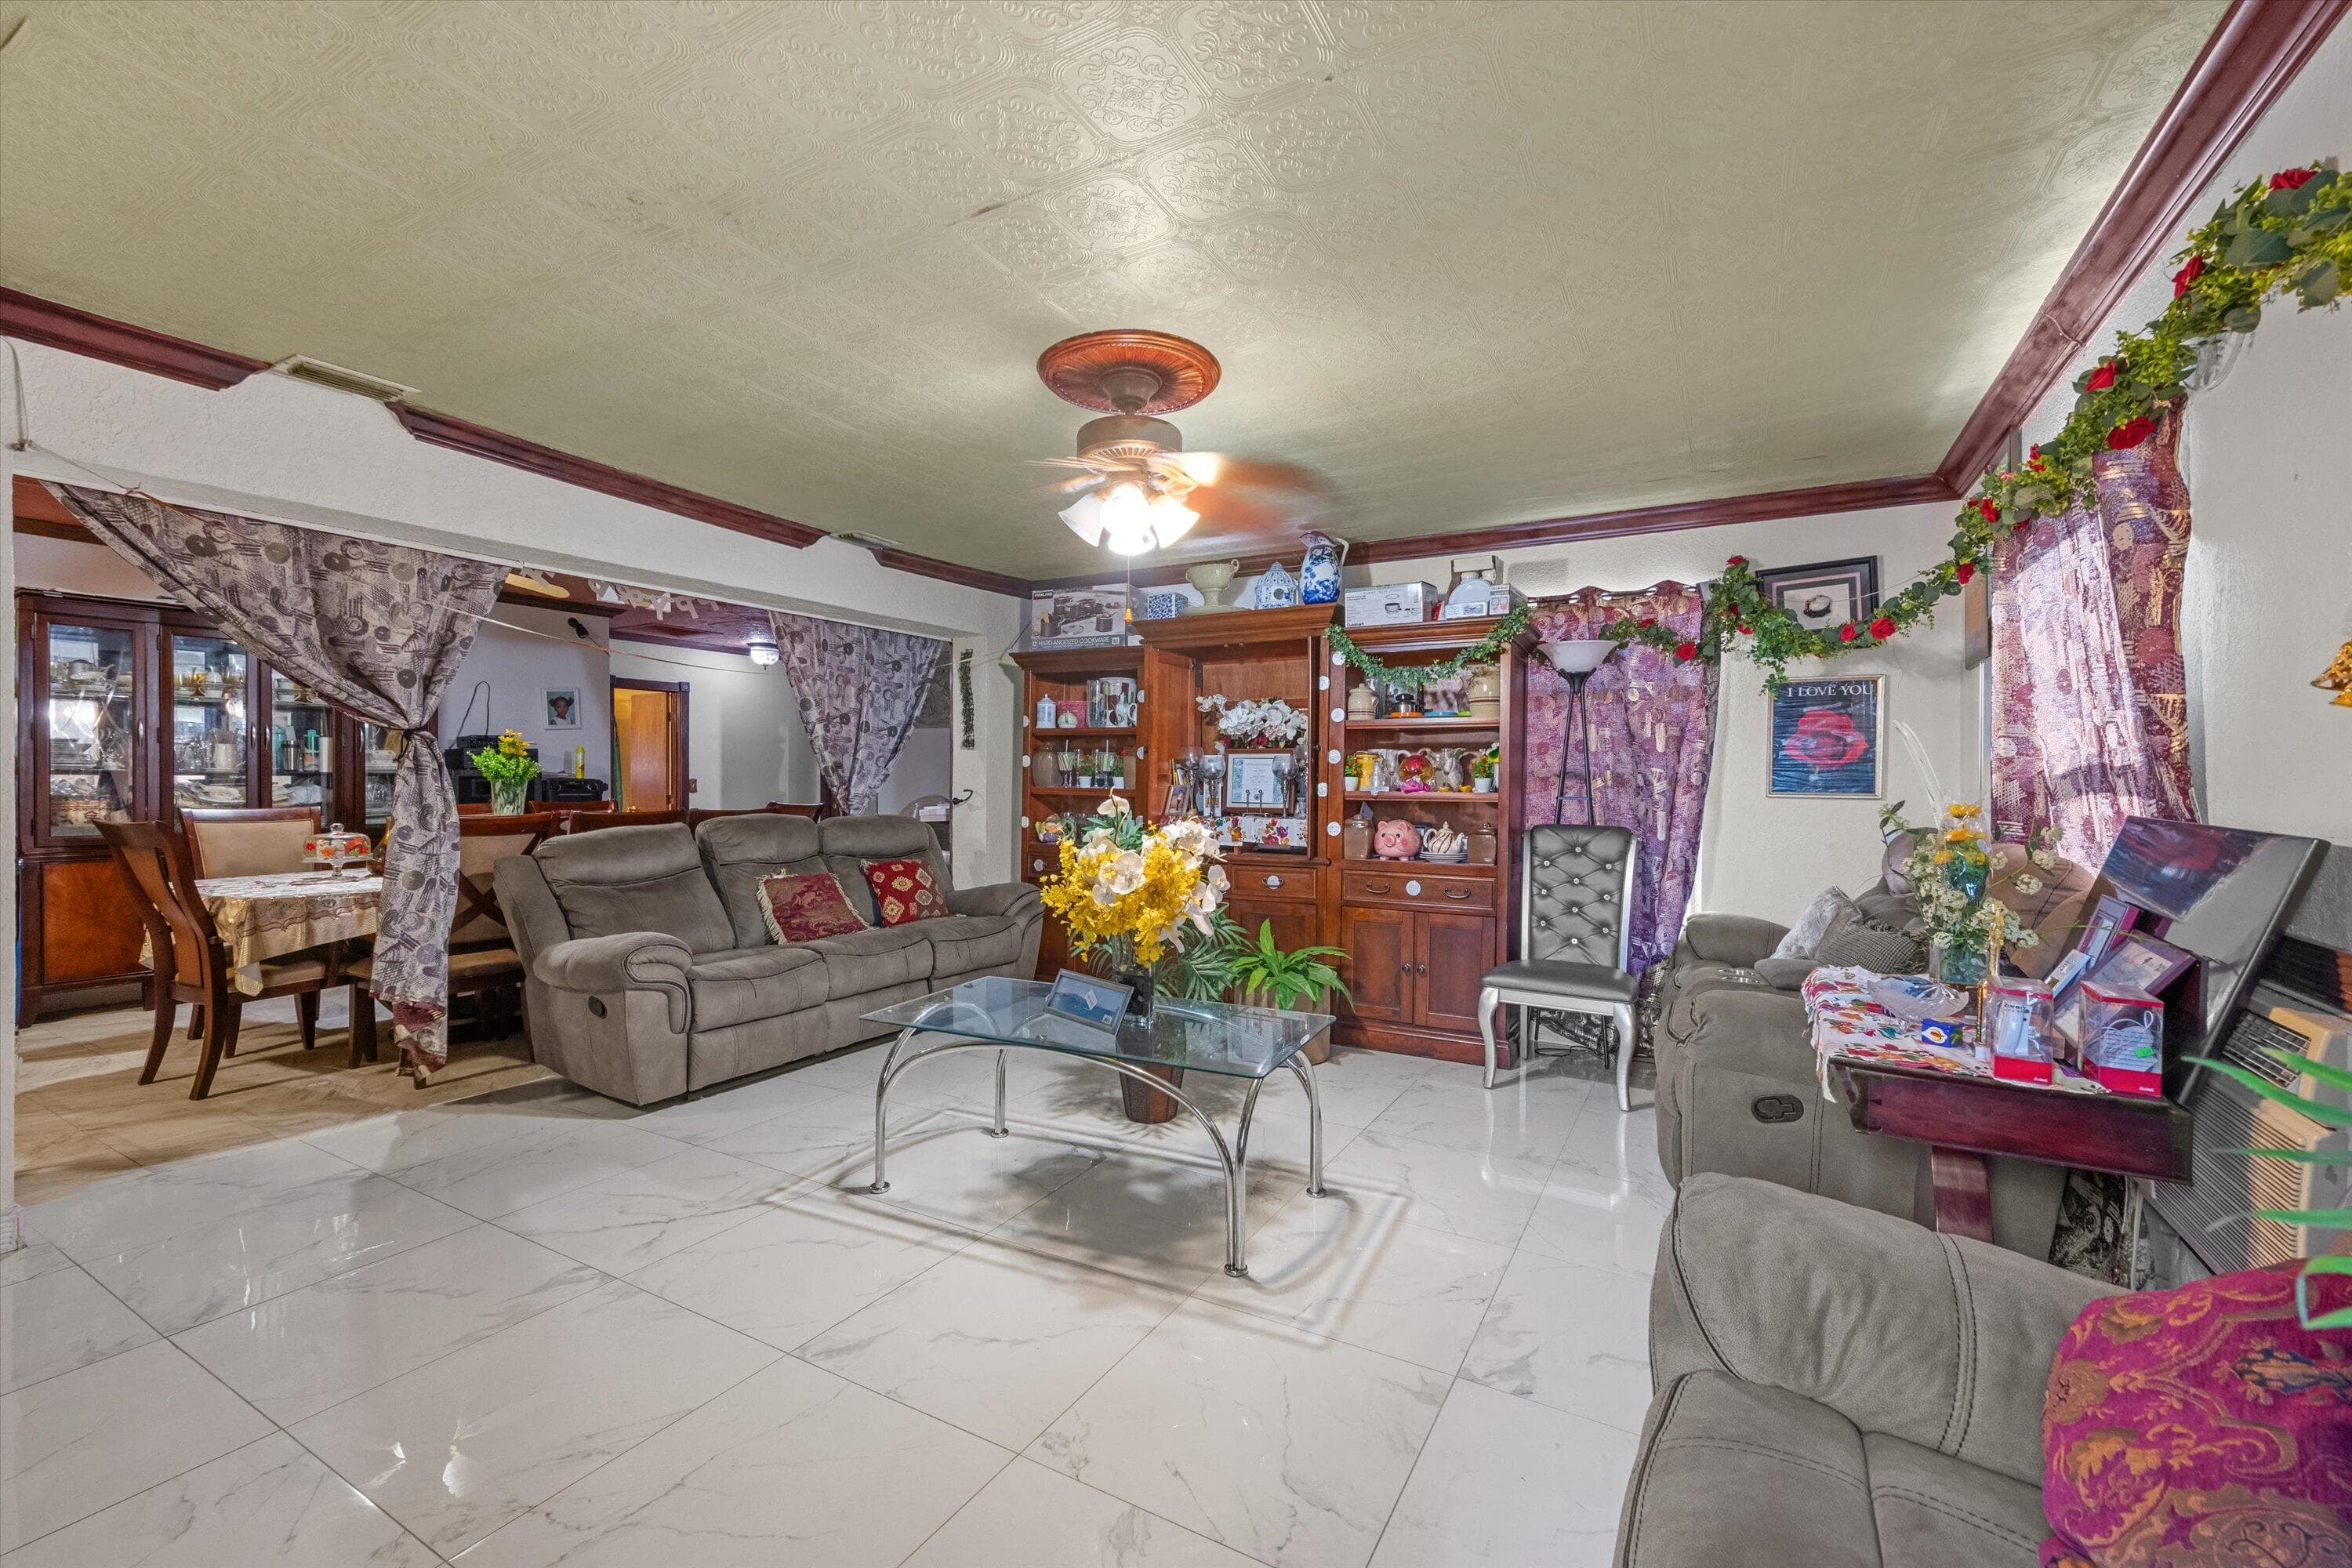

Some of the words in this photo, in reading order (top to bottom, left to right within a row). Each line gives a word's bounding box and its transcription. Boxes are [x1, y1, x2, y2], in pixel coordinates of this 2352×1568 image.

[1788, 688, 1794, 697] I
[1798, 686, 1837, 696] LOVE
[1841, 684, 1874, 695] YOU
